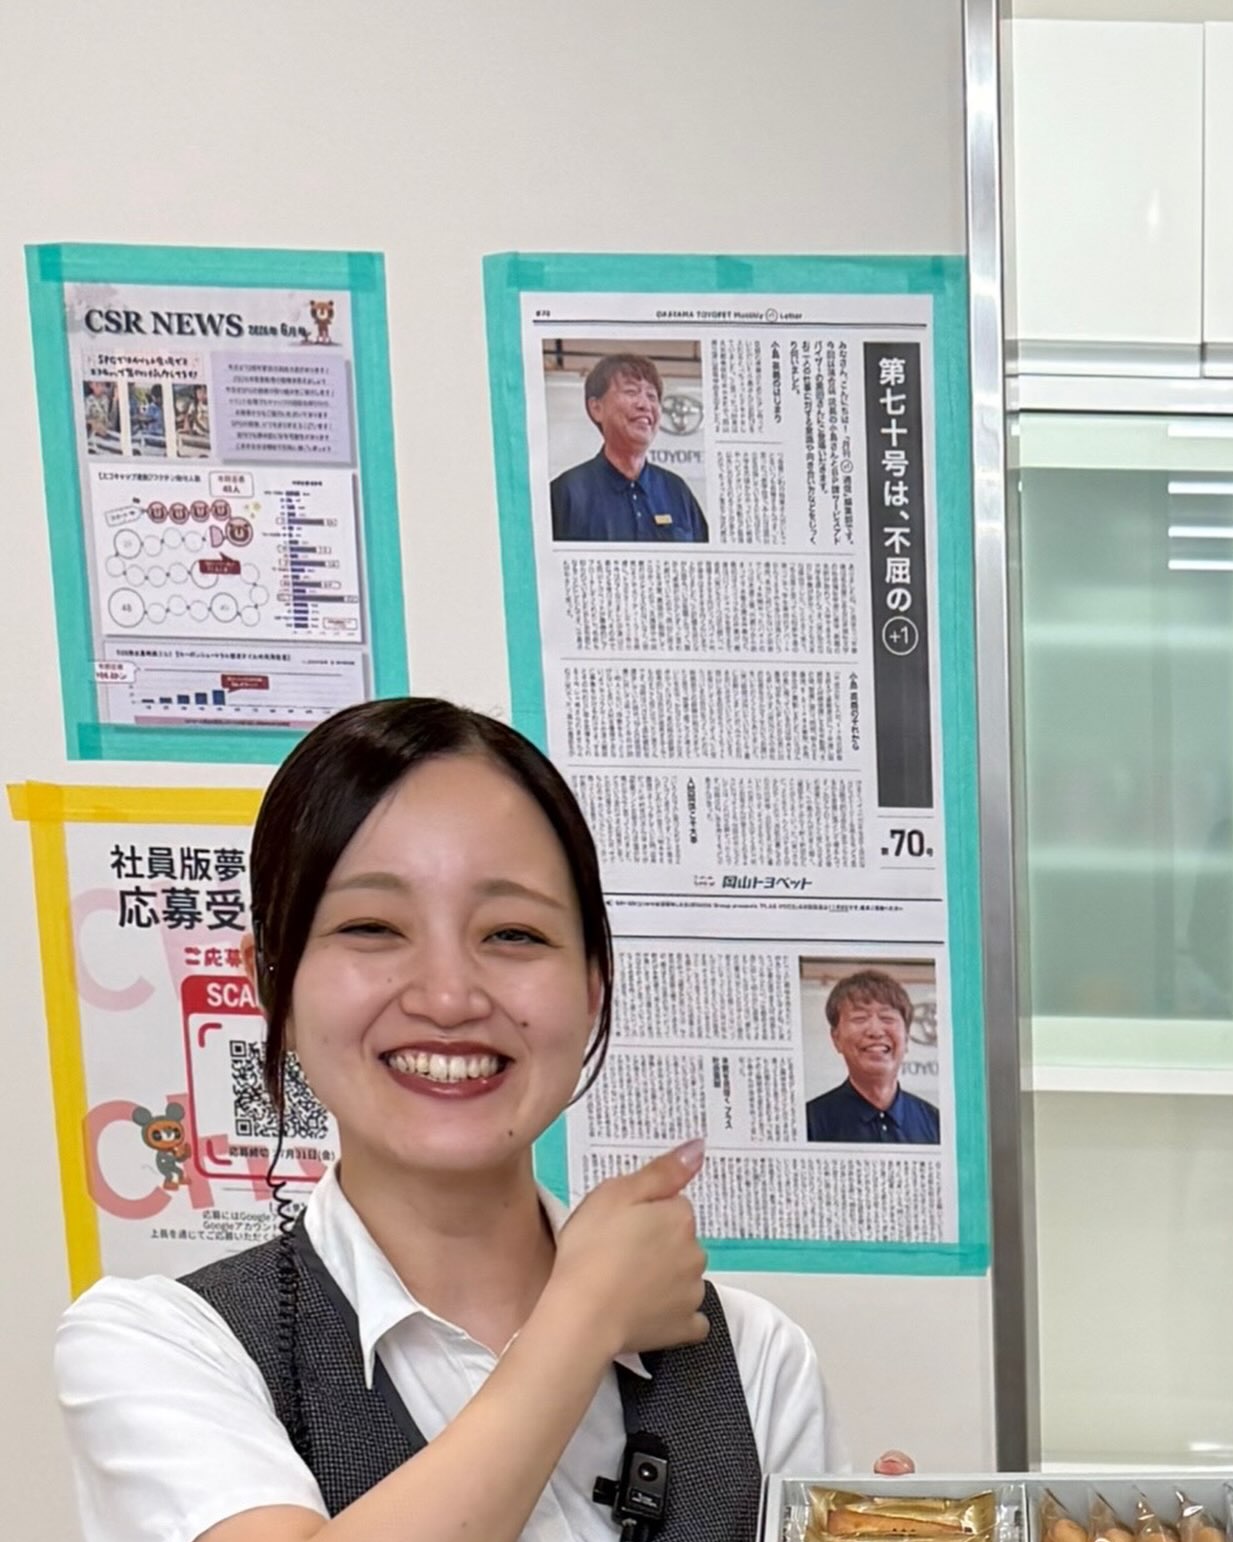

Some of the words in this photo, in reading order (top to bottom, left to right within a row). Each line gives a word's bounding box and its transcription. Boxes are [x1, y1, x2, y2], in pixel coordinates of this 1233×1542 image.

[84, 308, 143, 336] CSR
[150, 310, 243, 338] NEWS
[110, 844, 246, 882] 社員版夢
[118, 885, 246, 932] 応募受
[206, 982, 259, 1009] SCA
